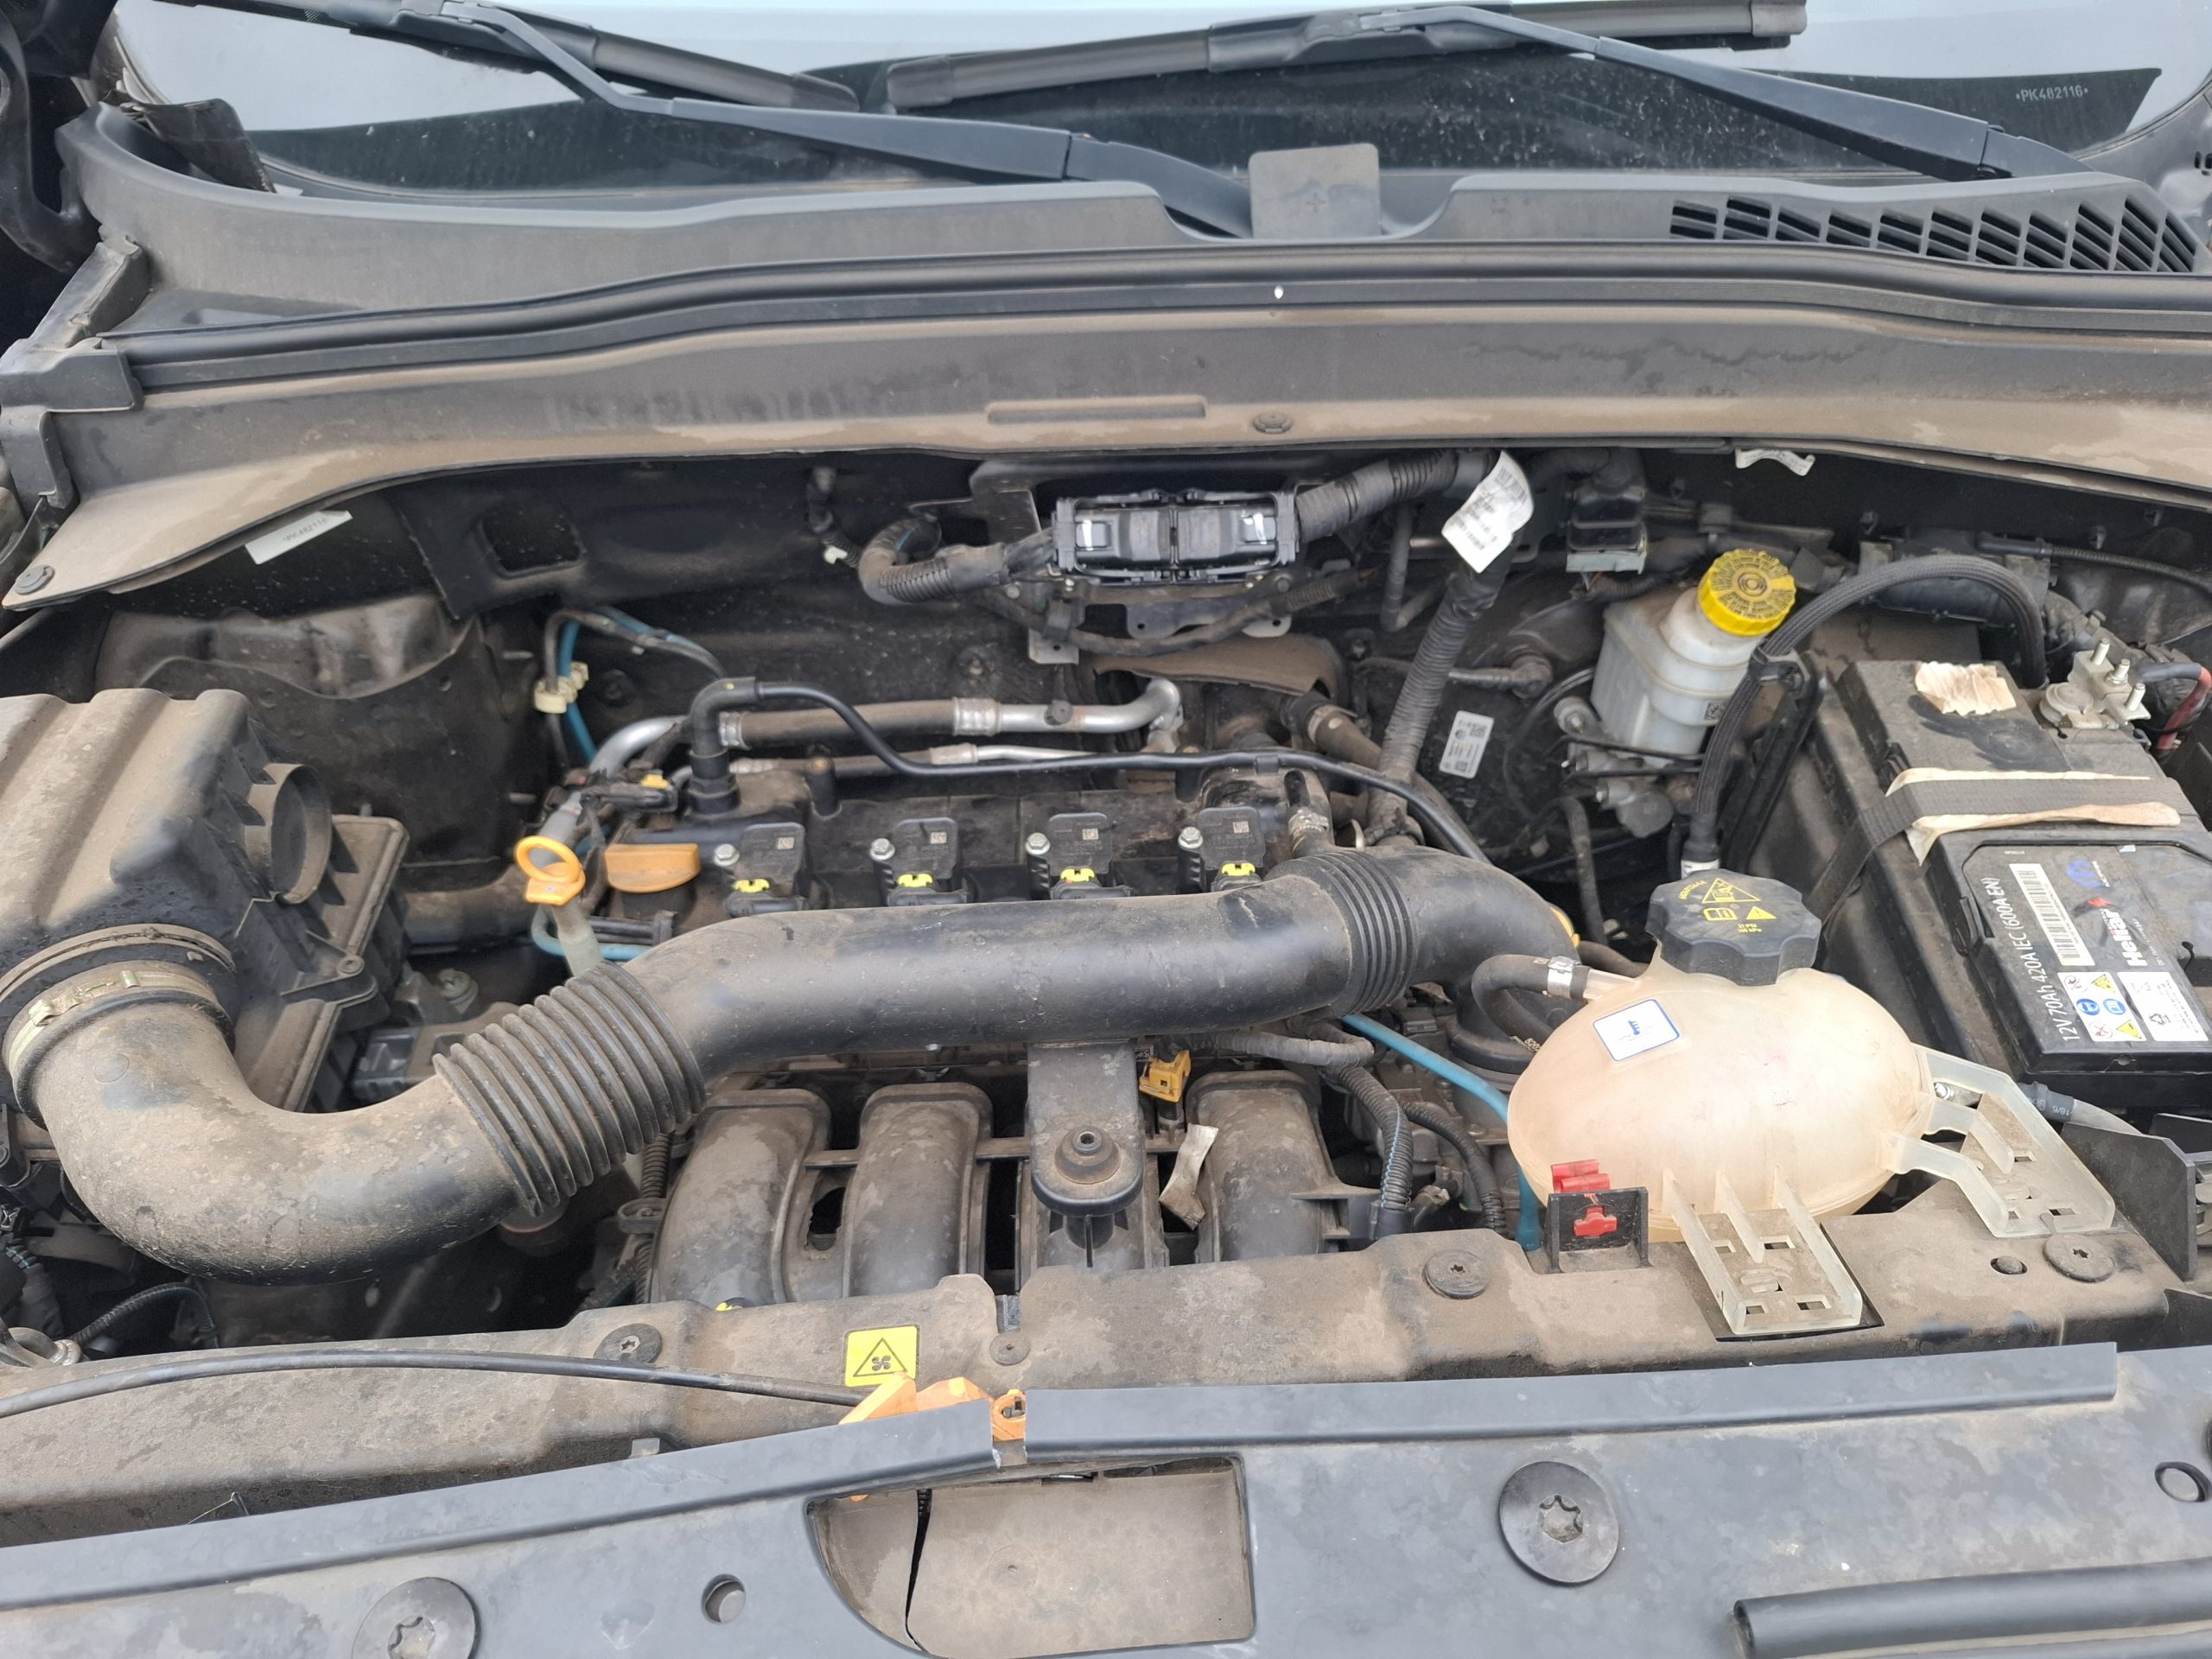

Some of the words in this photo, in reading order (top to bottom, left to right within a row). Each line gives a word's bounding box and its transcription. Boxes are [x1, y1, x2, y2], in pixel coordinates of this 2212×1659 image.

[1980, 877, 2005, 897] EN)
[1993, 898, 2024, 930] (600A
[2008, 931, 2033, 950] IEC
[2103, 908, 2148, 966] Heliar
[2020, 952, 2049, 982] 420A
[2037, 985, 2068, 1016] 70Ah
[2052, 1017, 2081, 1042] 12V
